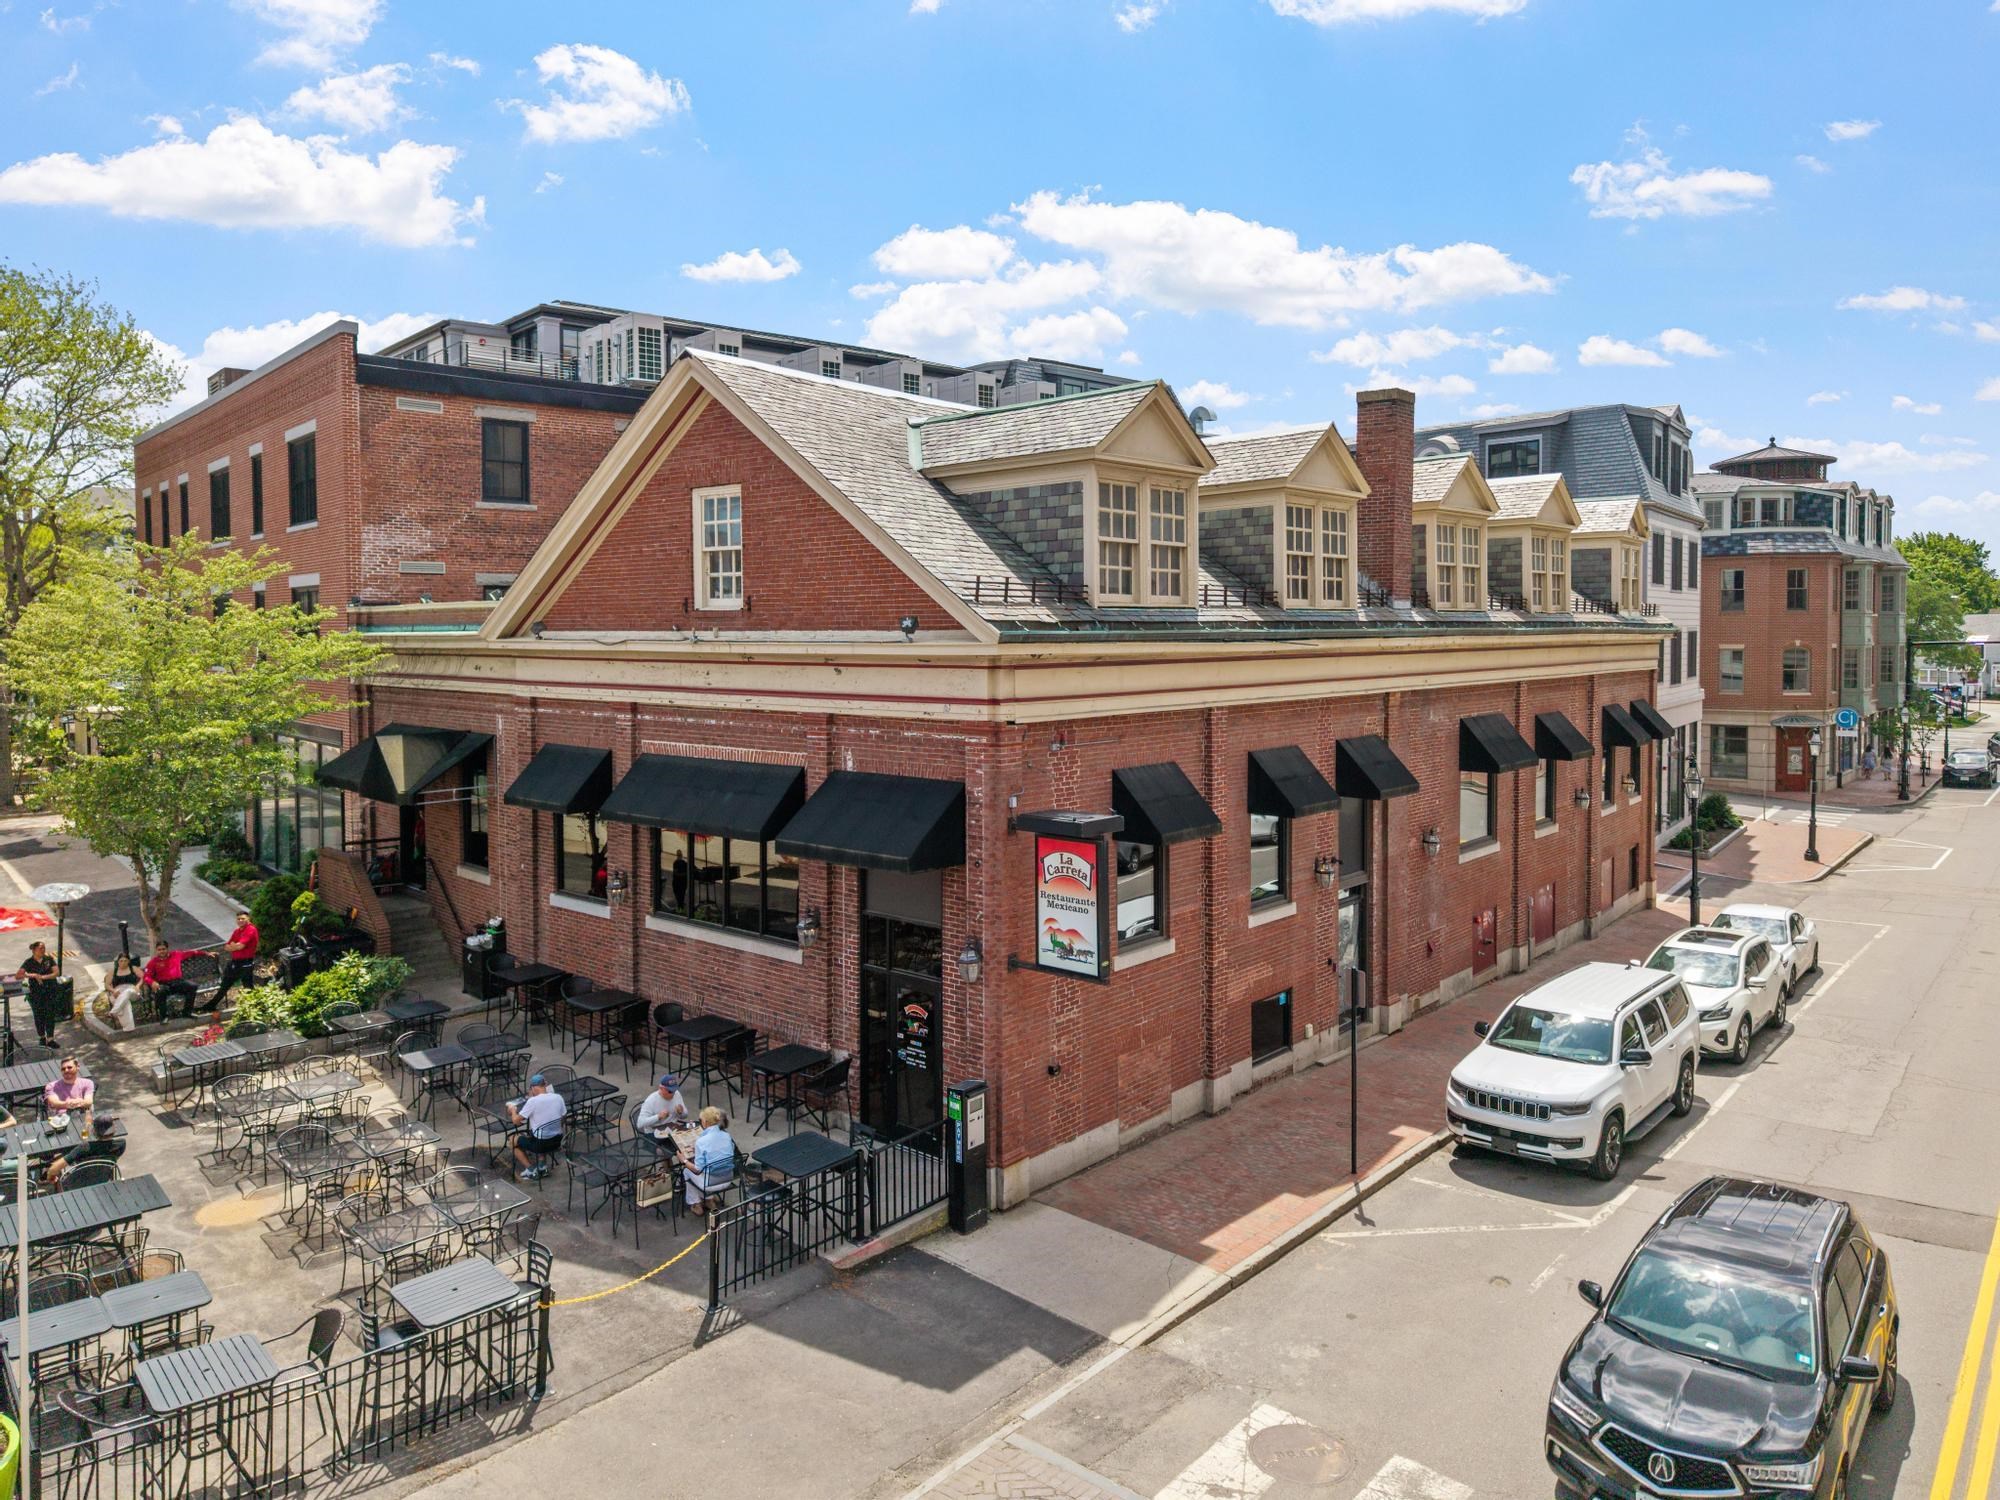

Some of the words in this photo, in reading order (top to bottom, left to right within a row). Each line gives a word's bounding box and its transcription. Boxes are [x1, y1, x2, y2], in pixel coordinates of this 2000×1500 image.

[1059, 853, 1073, 866] La
[1047, 864, 1088, 882] Carreta
[1040, 890, 1096, 907] Restaurante
[1046, 900, 1089, 915] Mexicano
